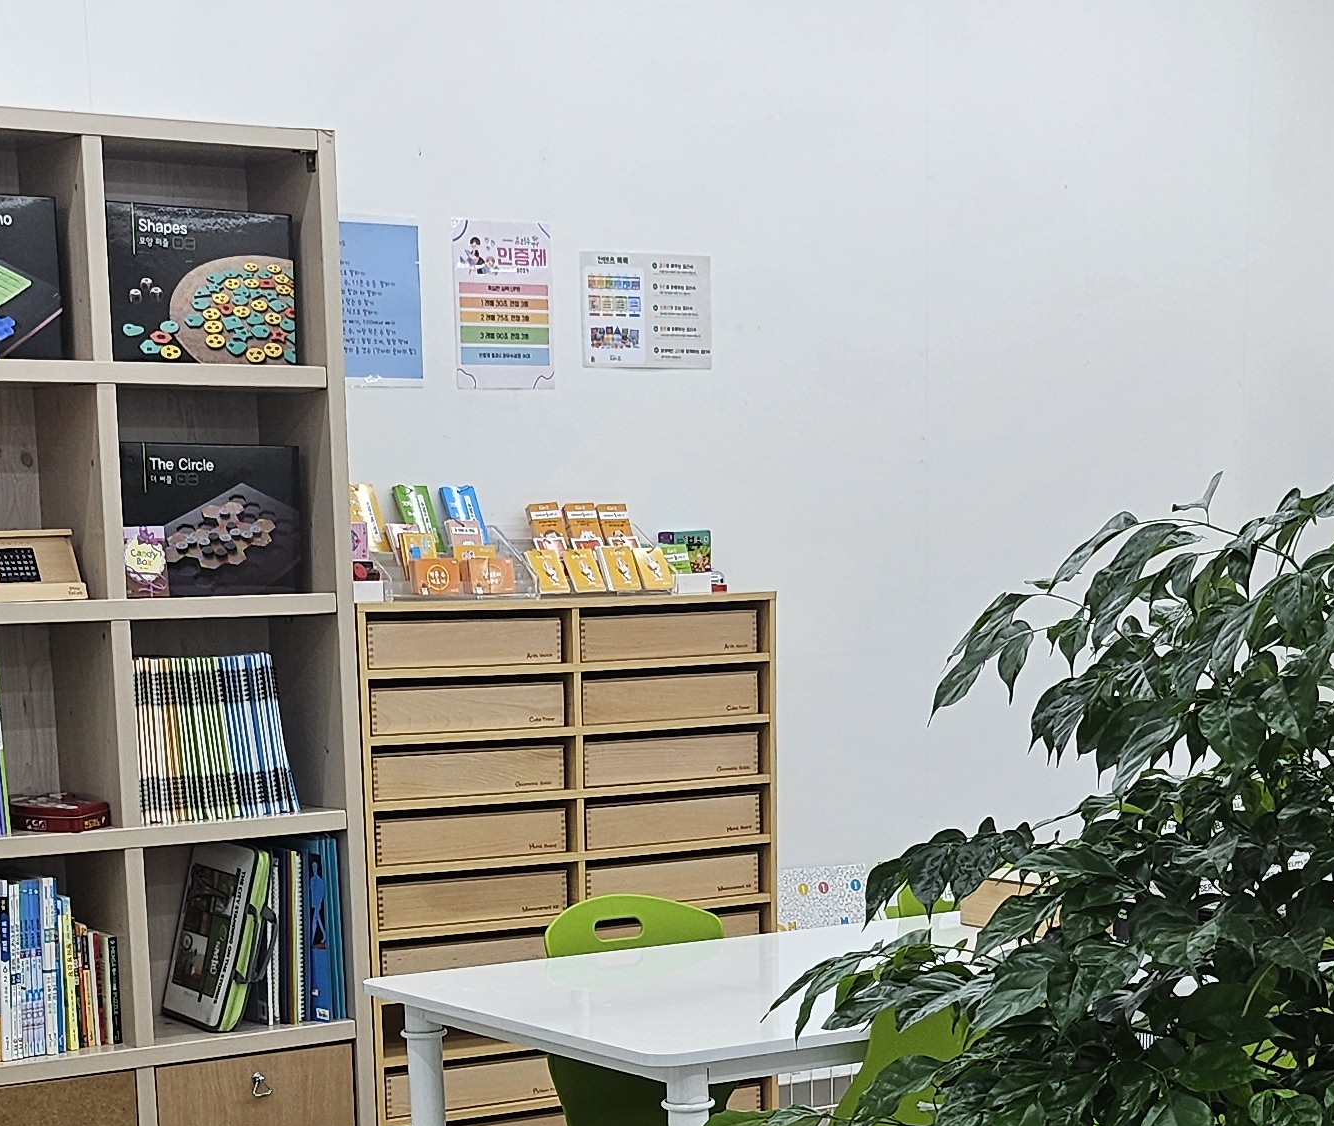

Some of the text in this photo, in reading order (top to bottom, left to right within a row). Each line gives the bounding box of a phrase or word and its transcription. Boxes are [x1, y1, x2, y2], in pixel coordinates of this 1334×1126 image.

[138, 218, 188, 236] Shapes
[496, 247, 547, 267] 인증제
[148, 457, 215, 472] The Circle
[130, 548, 159, 560] Candy
[136, 557, 153, 567] Box
